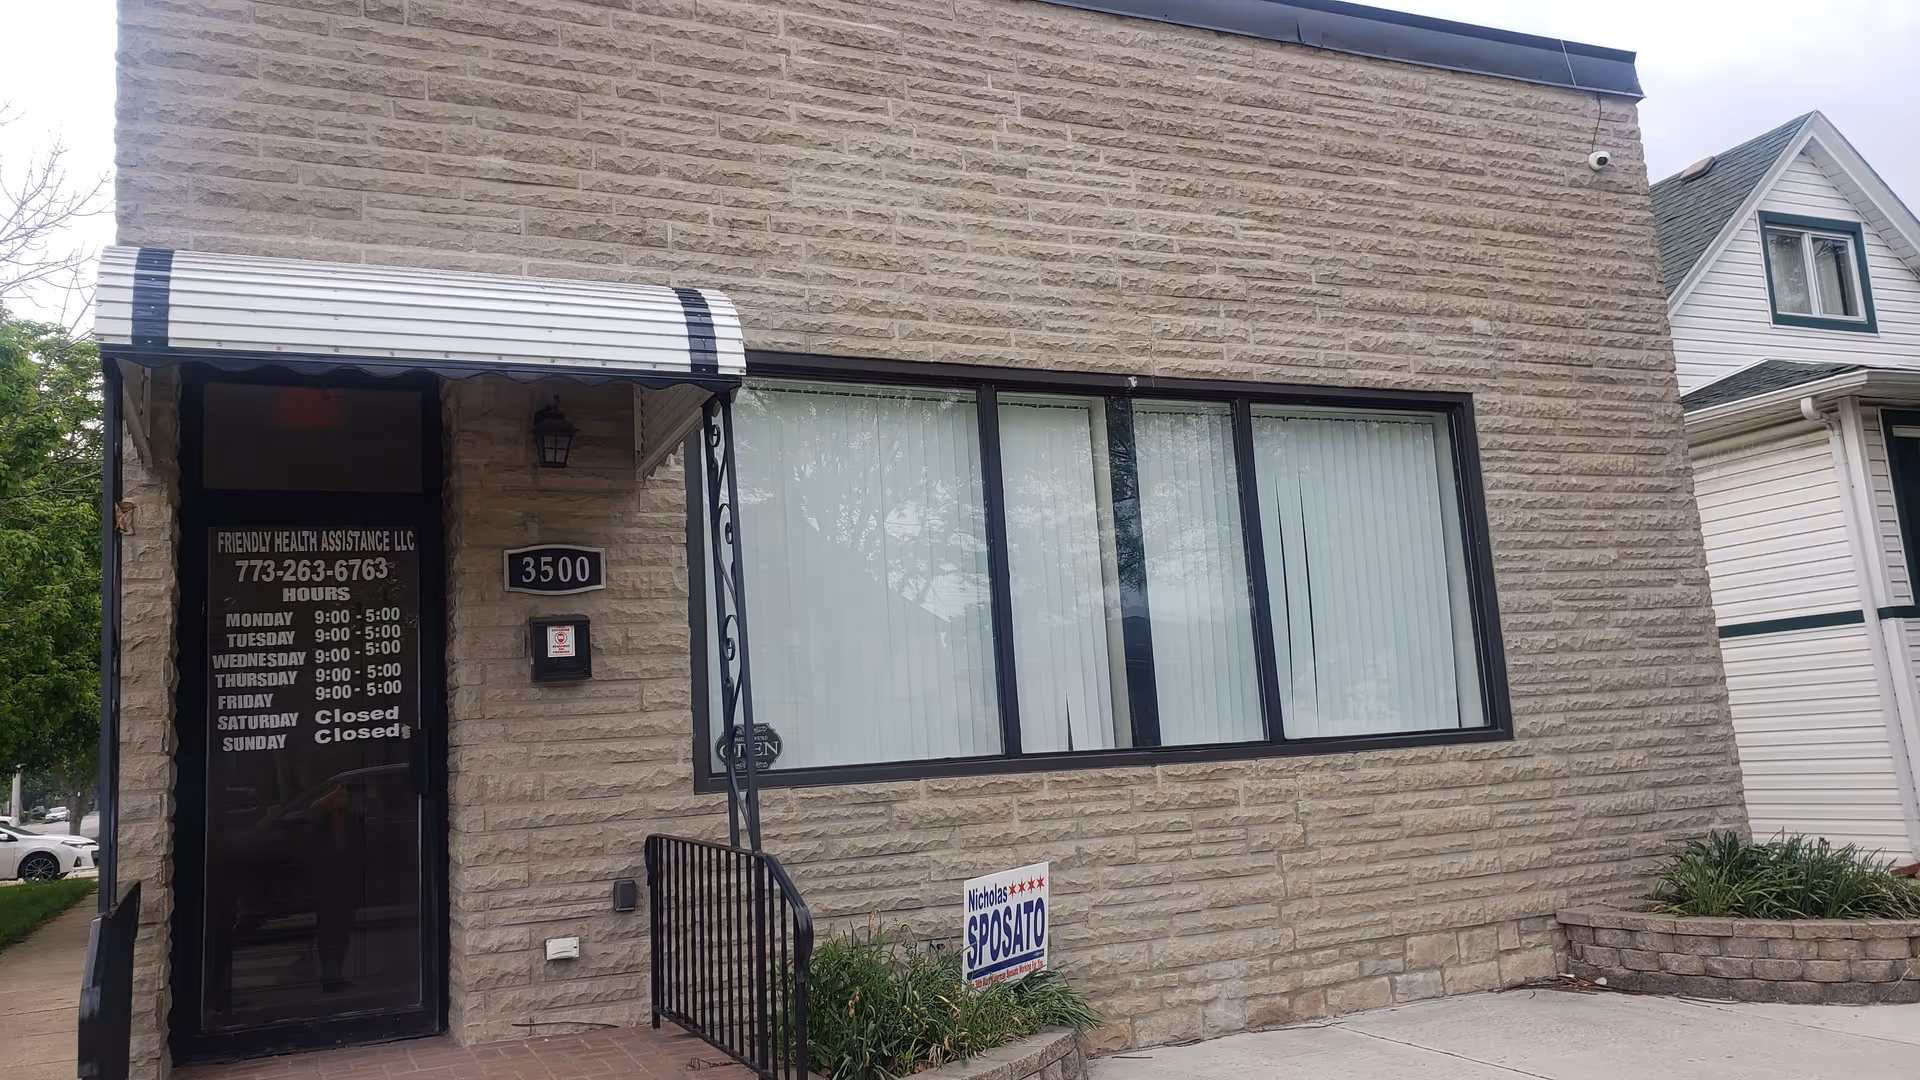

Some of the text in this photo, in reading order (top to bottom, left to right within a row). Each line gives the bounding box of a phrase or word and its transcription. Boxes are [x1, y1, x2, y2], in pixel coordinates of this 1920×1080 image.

[217, 529, 415, 553] FRIENDLY HEALTH ASSISTANCE LLC
[235, 556, 389, 583] 773-263-6763
[521, 556, 590, 583] 3500
[282, 586, 351, 602] HOURS
[225, 611, 294, 628] MONDAY
[314, 609, 350, 624] 9:00
[365, 607, 400, 623] 5:00
[226, 630, 296, 648] TUESDAY
[315, 627, 350, 643] 9:00
[365, 624, 401, 640] 5:00
[212, 651, 307, 669] WEDNESDAY
[315, 647, 351, 663] 9:00
[365, 640, 401, 656] 5:00
[215, 670, 298, 688] THURSDAY
[315, 667, 352, 683] 9:00
[367, 662, 401, 679] 5:00
[217, 693, 274, 710] FRIDAY
[315, 684, 352, 701] 9:00
[366, 680, 402, 697] 5:00
[217, 705, 400, 731] SATURDAY Closed
[222, 722, 400, 752] SUNDAY Closed
[968, 883, 1008, 912] Nicholas
[966, 897, 1045, 969] SPOSATO
